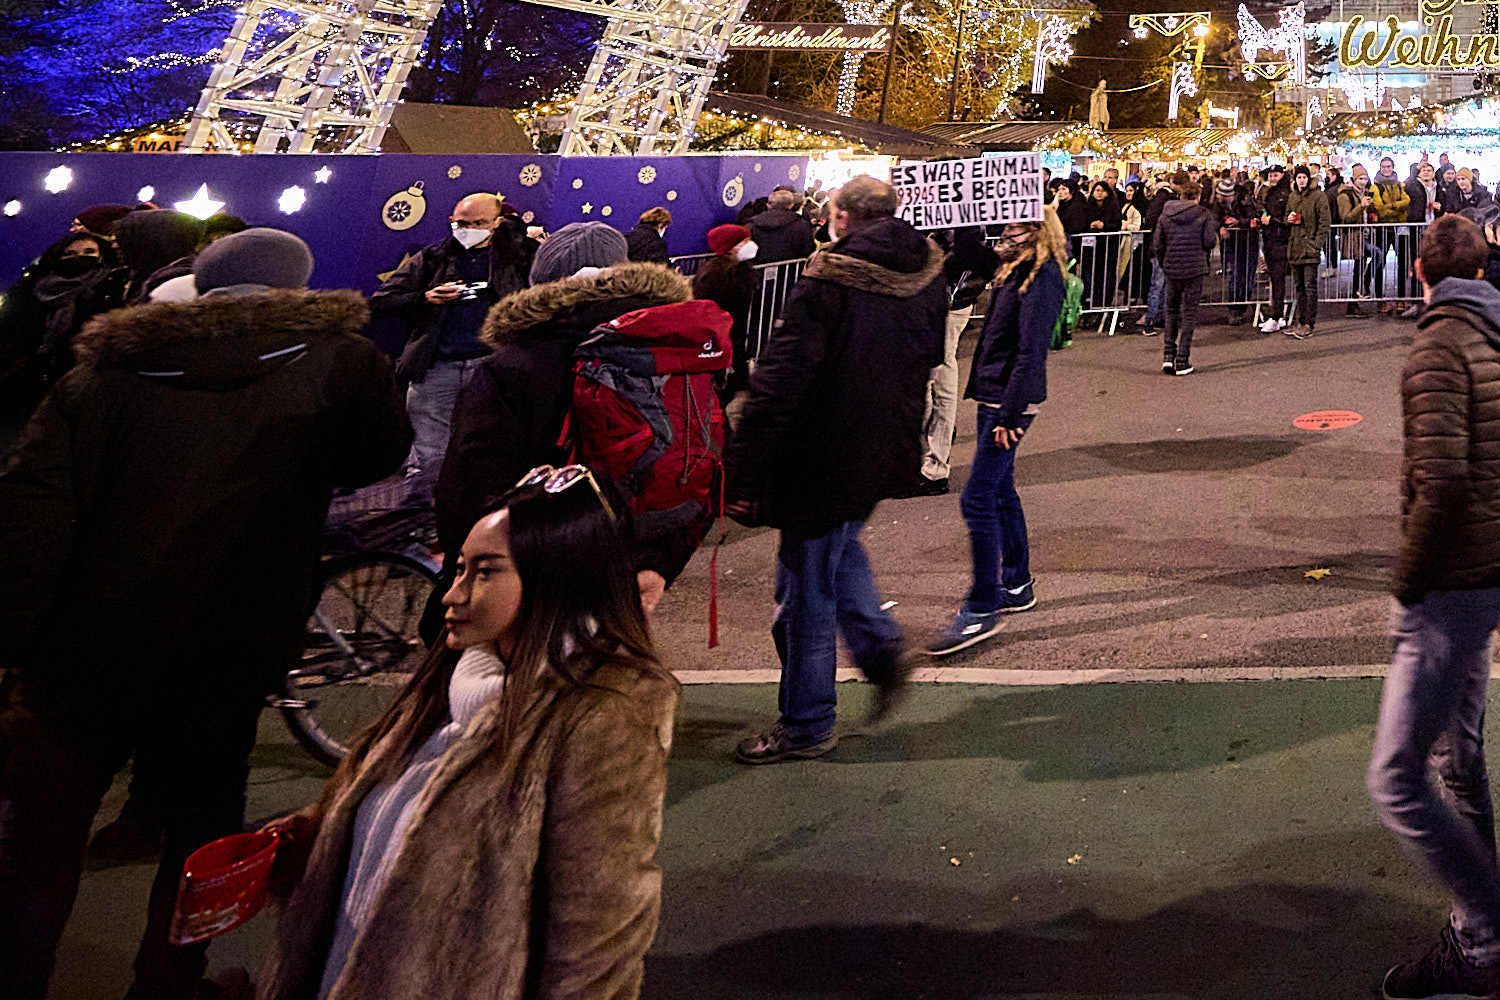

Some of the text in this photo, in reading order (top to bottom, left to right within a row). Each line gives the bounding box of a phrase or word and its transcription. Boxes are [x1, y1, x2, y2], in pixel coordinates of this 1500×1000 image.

[729, 23, 892, 49] Christkindlmarkt
[891, 157, 1039, 186] ES WAR EINMAL
[938, 182, 963, 203] ES
[972, 177, 1039, 201] BEGANN
[960, 202, 988, 224] WIE
[990, 198, 1037, 221] JETZT
